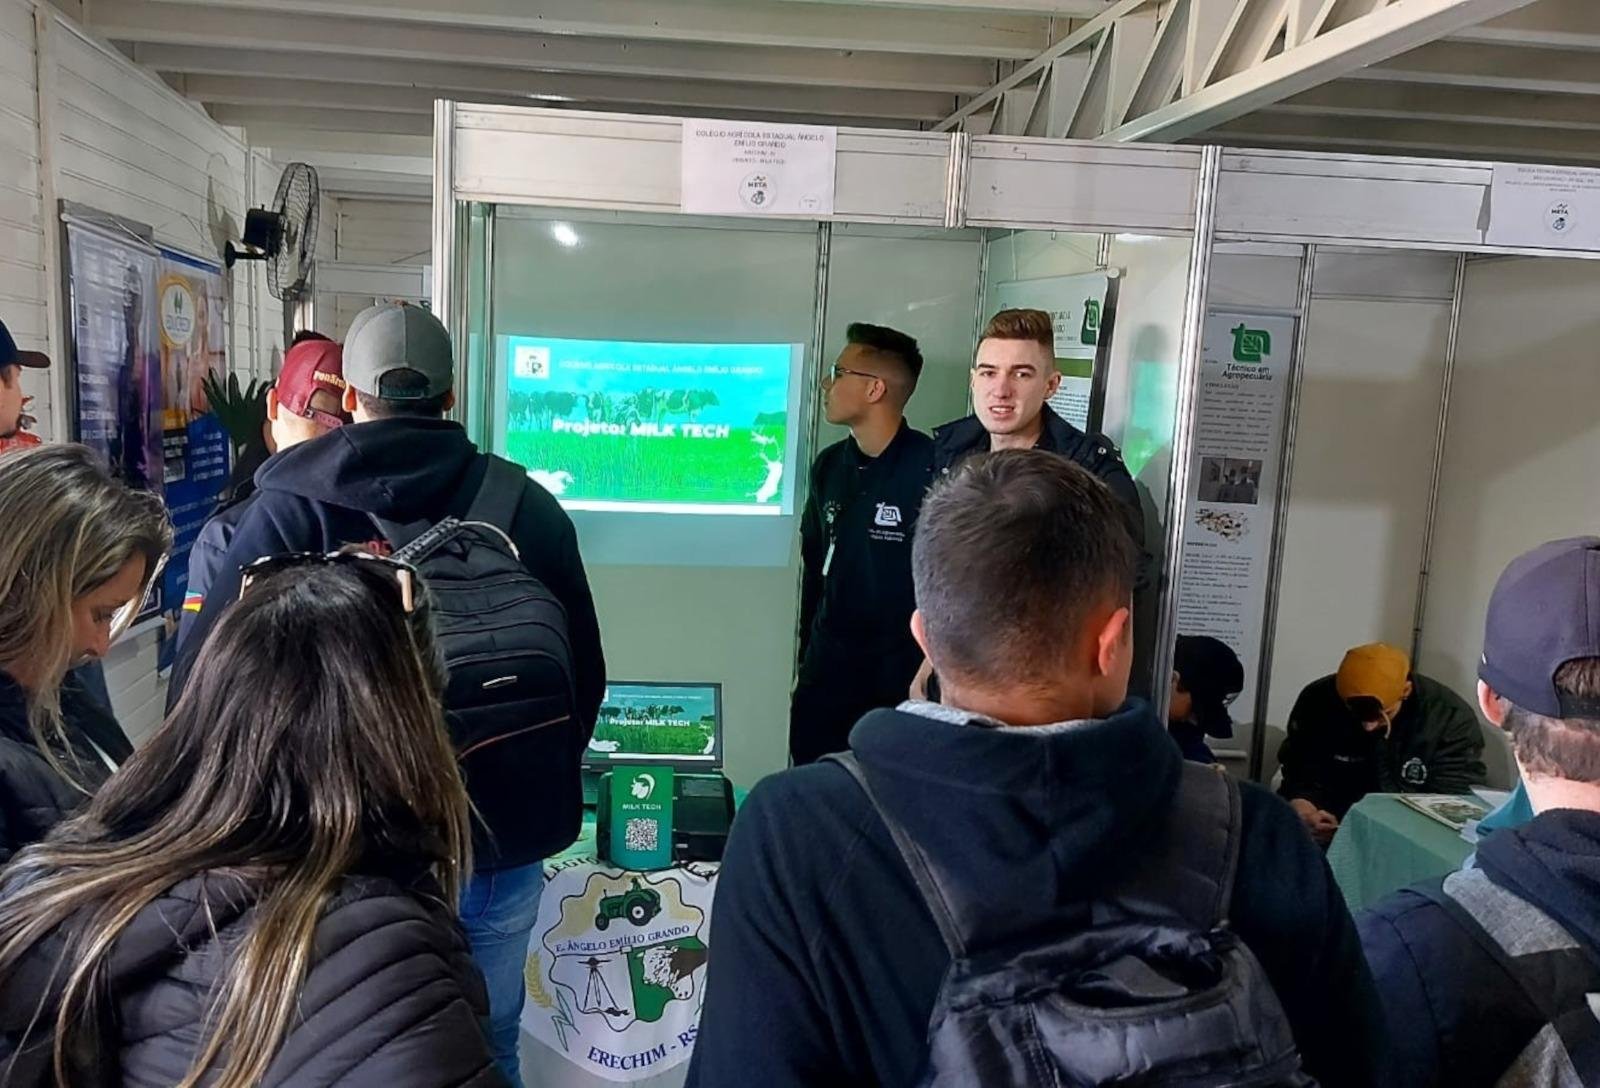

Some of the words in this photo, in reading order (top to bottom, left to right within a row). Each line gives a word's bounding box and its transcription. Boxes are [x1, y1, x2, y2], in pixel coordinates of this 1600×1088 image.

[552, 418, 624, 438] Projeto:
[630, 422, 675, 437] MILK
[681, 423, 730, 438] TECH
[668, 719, 690, 727] TECH
[543, 856, 601, 883] LEGIO
[567, 940, 606, 952] ÂNGELO
[609, 934, 645, 949] EMÍLIO
[648, 925, 690, 941] GRANDO
[587, 1043, 667, 1071] ERECHIM
